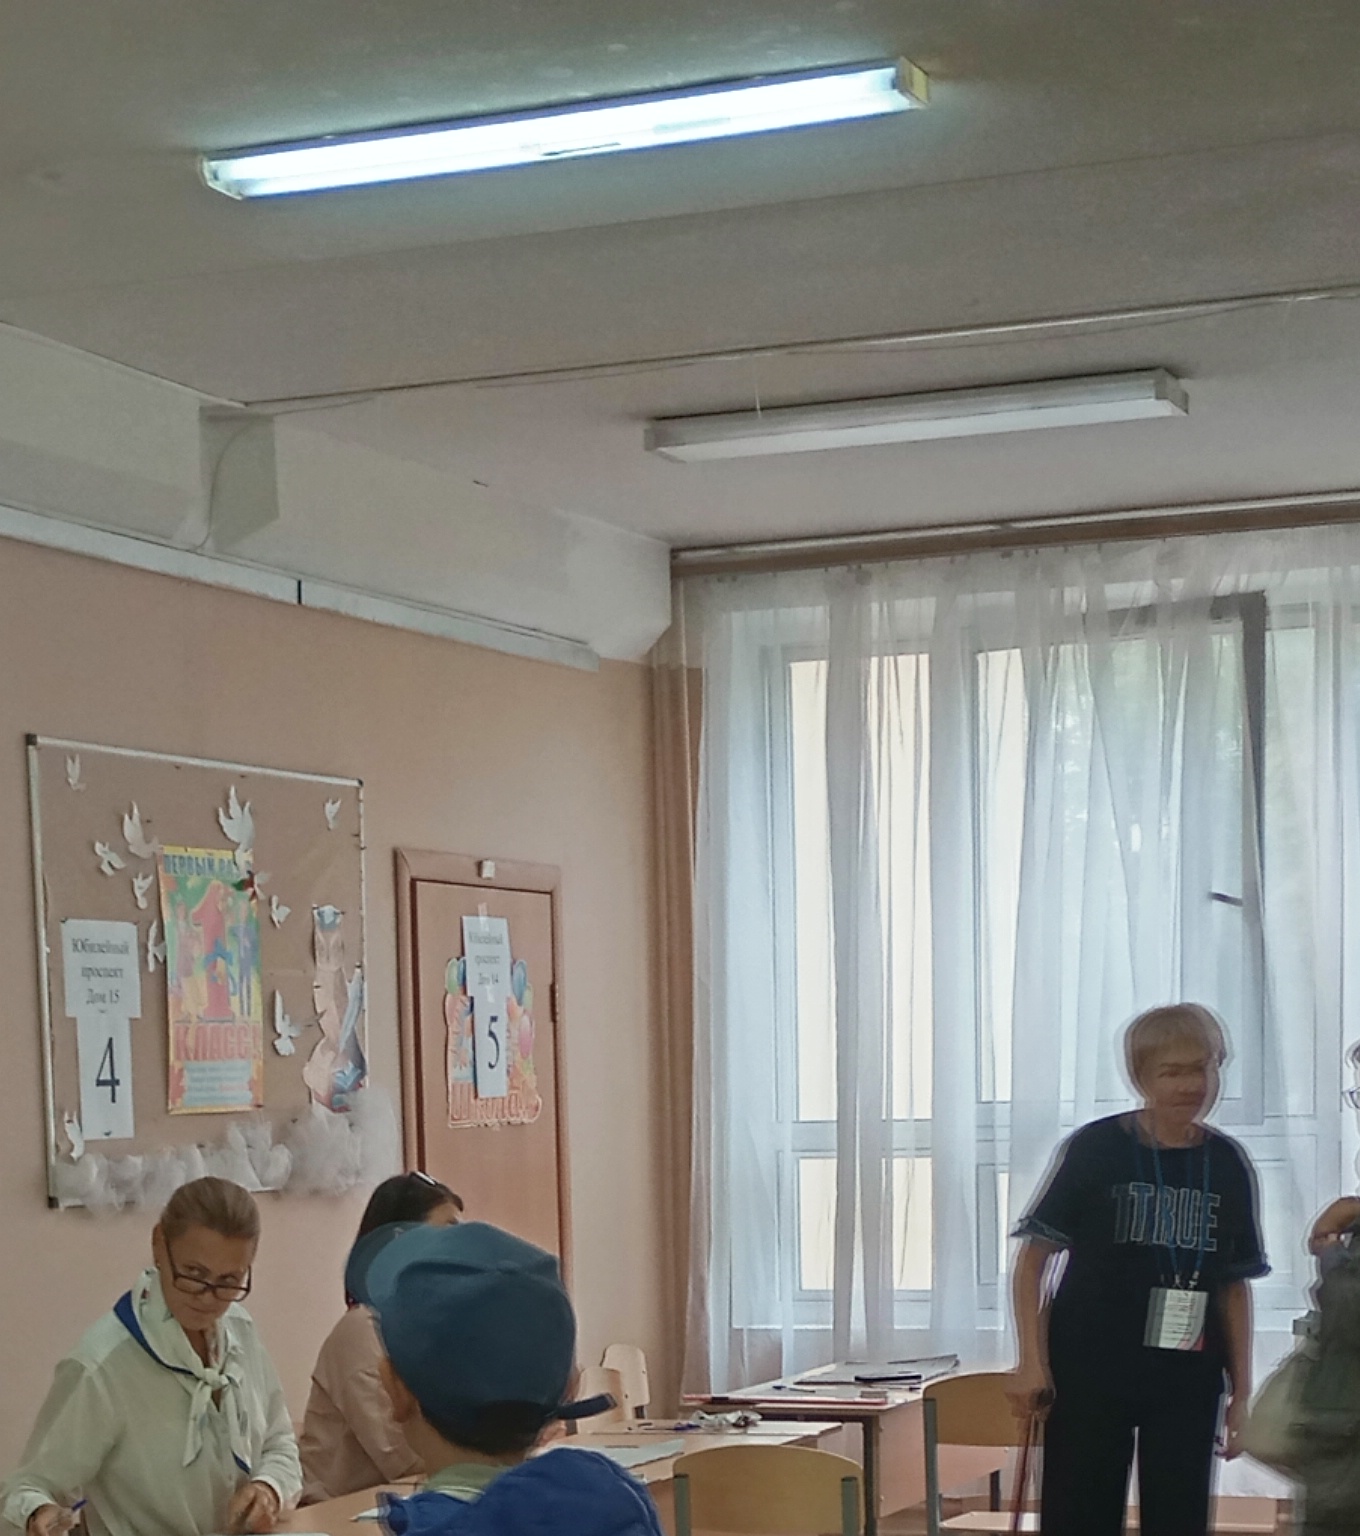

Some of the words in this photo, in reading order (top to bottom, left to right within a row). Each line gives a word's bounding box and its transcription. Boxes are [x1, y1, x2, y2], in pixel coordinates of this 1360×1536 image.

[175, 1023, 261, 1060] КЛАСС!
[487, 1015, 500, 1069] 5
[95, 1036, 121, 1104] 4
